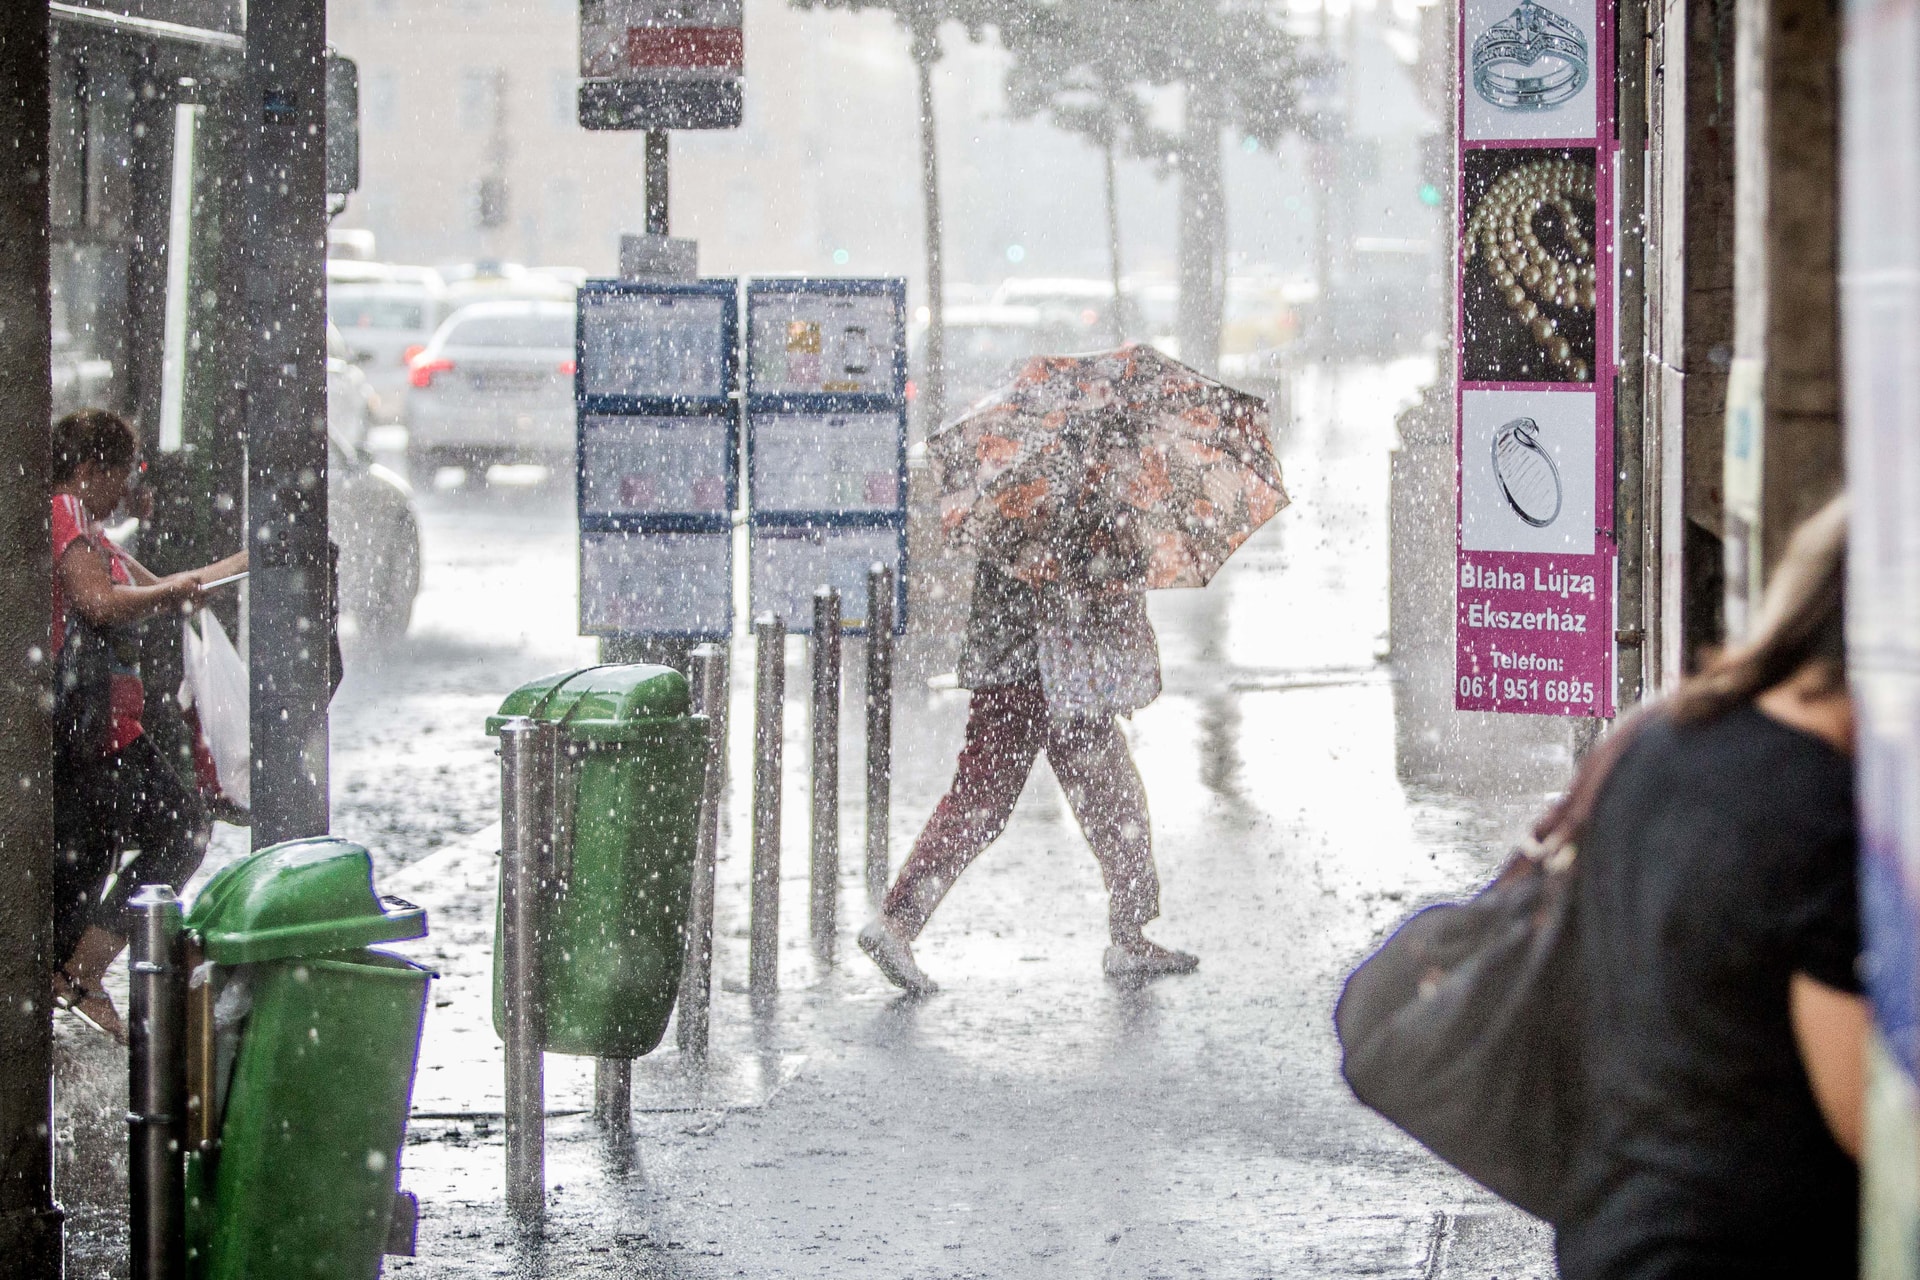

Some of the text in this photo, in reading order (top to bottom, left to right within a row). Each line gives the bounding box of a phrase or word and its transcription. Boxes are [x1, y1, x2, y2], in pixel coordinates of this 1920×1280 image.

[1461, 564, 1595, 598] Blaha Lujza
[1468, 599, 1586, 632] Ékszerház
[1490, 651, 1564, 671] Telefon:
[1459, 675, 1594, 703] 06 1 951 6825
